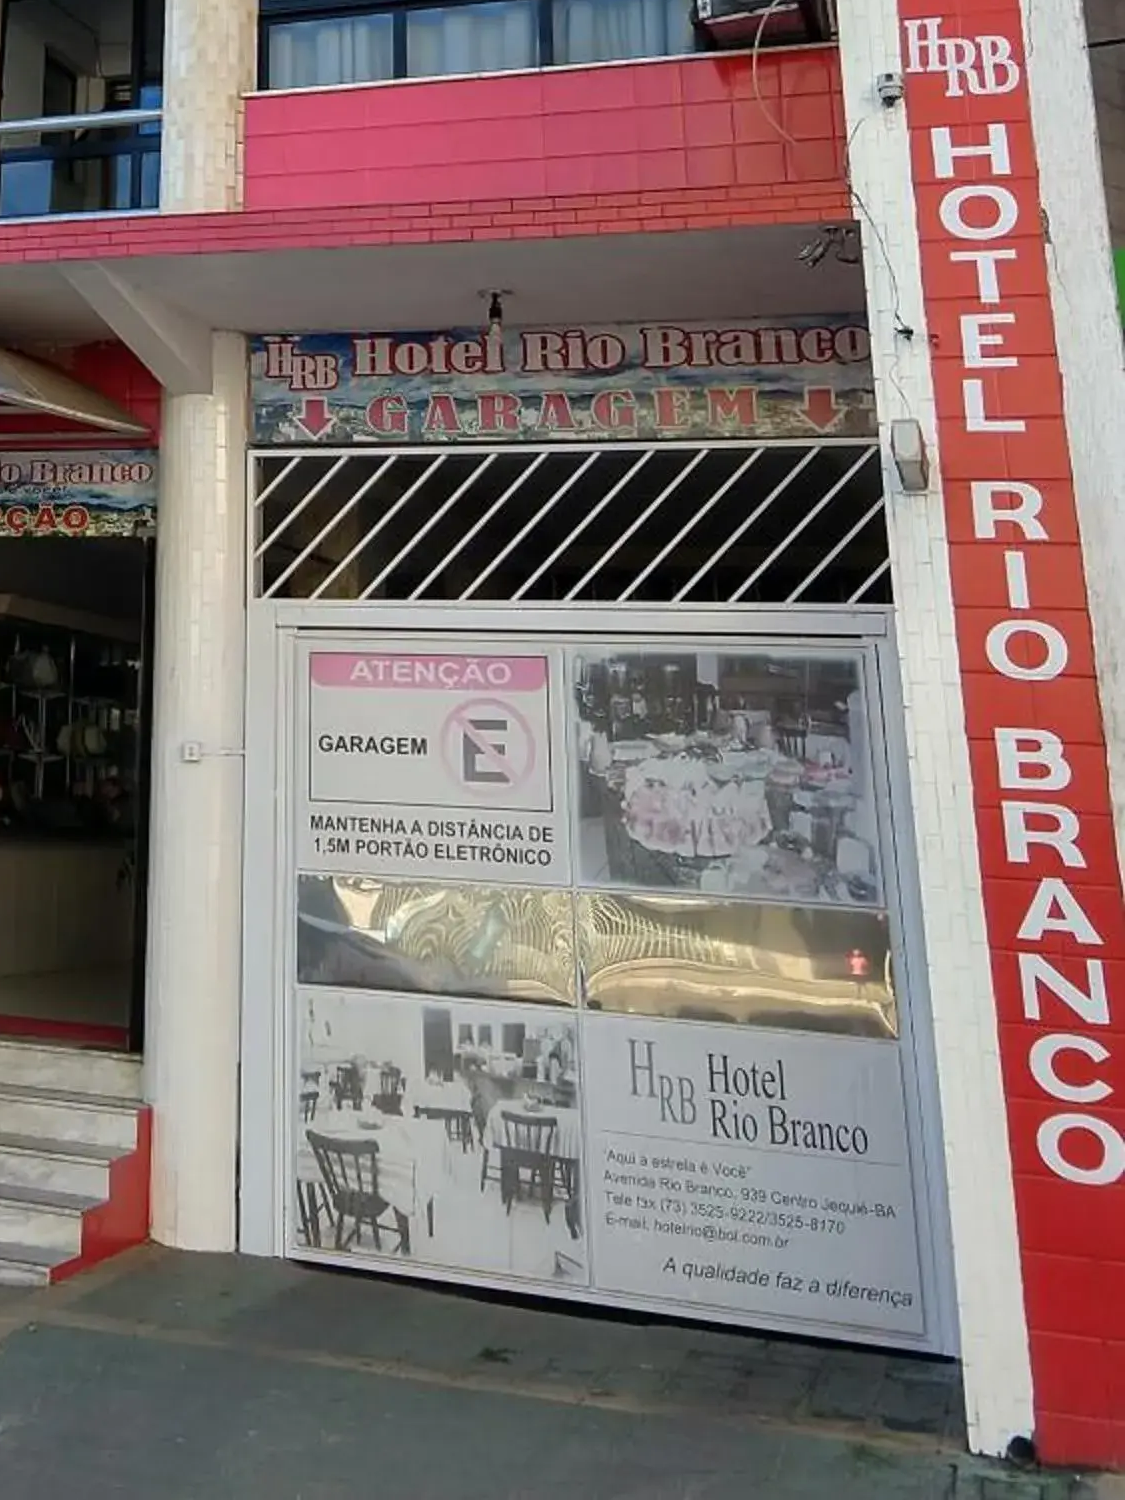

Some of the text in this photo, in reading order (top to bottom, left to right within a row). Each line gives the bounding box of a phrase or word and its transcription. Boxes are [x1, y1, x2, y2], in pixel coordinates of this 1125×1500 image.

[904, 17, 1020, 97] HRB
[265, 325, 870, 392] HRB Hotel Rio Branco
[366, 385, 760, 435] GARAGEM
[30, 459, 153, 485] Branco
[350, 657, 512, 688] ATENÇÃO
[930, 123, 1125, 1186] HOTEL RIO BRANCO
[318, 734, 428, 756] GARAGEM
[310, 815, 555, 843] MANTENHA A DISTÂNCIA DE
[356, 836, 429, 859] PORTÃO
[434, 841, 552, 867] ELETRÔNICO
[628, 1038, 787, 1126] HRB Hotel
[711, 1100, 869, 1156] Rio Branco
[662, 1256, 914, 1309] A qualidade faz a diferença
